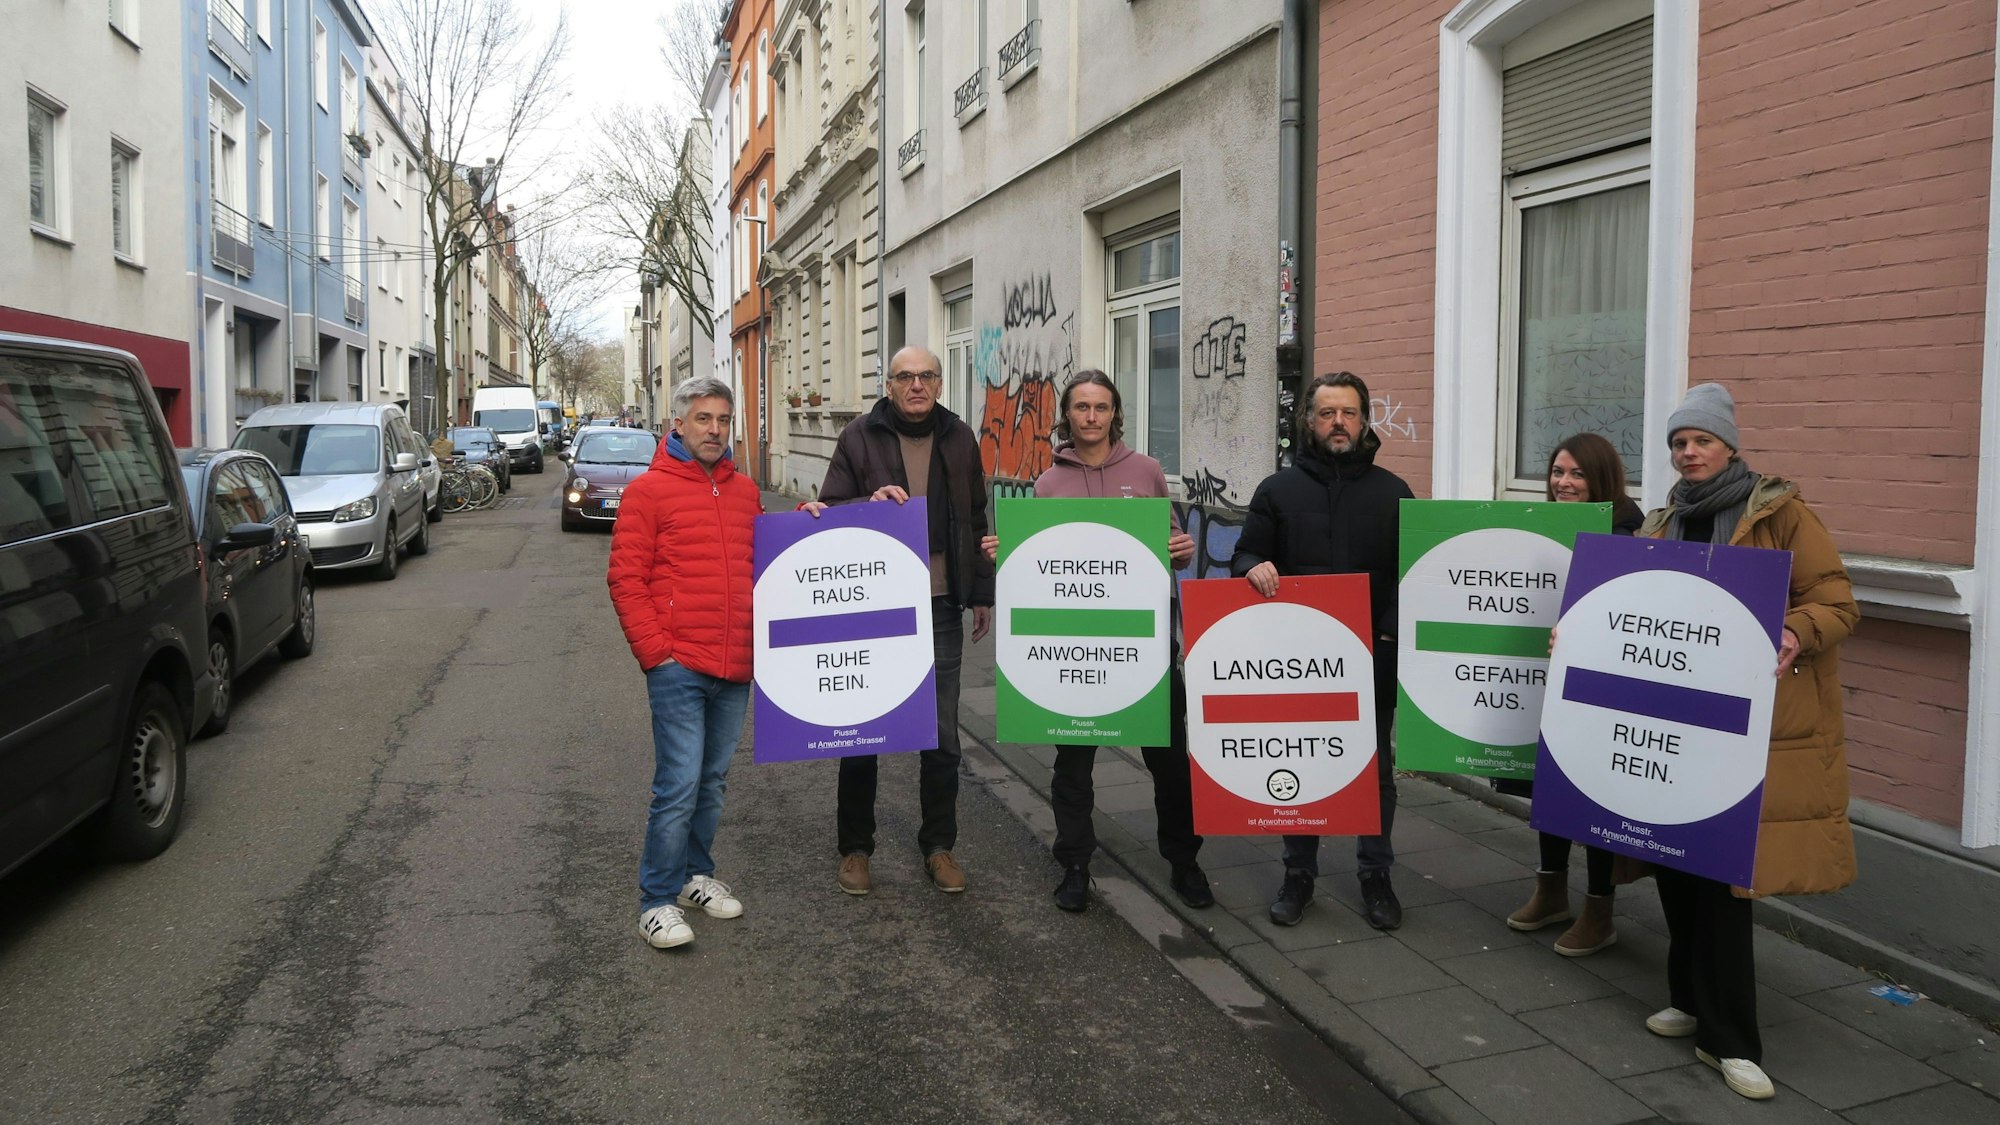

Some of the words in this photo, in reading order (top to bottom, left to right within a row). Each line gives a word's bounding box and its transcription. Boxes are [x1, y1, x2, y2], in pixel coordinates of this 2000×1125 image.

[795, 561, 886, 584] VERKEHR
[1037, 559, 1128, 576] VERKEHR
[1448, 568, 1558, 590] VERKEHR
[813, 585, 870, 605] RAUS.
[1054, 582, 1110, 599] RAUS.
[1468, 594, 1535, 615] RAUS.
[1608, 611, 1721, 647] VERKEHR
[816, 649, 871, 670] RUHE
[1027, 645, 1139, 663] ANWOHNER
[1622, 643, 1693, 674] RAUS.
[1059, 668, 1107, 685] FREI!
[1213, 657, 1344, 681] LANGSAM
[1455, 664, 1547, 686] GEFAHR
[818, 674, 869, 693] REIN.
[1473, 691, 1525, 711] AUS.
[1056, 728, 1121, 736] Anwohner-Strasse!
[1071, 719, 1097, 727] Piusstr.
[808, 741, 817, 749] ist
[818, 736, 886, 749] Anwohner-Strasse!
[833, 729, 860, 737] Piusstr.
[1612, 724, 1681, 755] RUHE
[1484, 747, 1514, 758] Piusstr.
[1455, 755, 1465, 764] ist
[1466, 756, 1536, 770] Anwohner-Strass
[1611, 754, 1673, 785] REIN.
[1258, 817, 1328, 826] Anwohner-Strasse!
[1273, 808, 1300, 816] Piusstr.
[1621, 821, 1654, 837] Piusstr.
[1590, 824, 1601, 835] ist
[1601, 828, 1685, 858] Anwohner-Strasse!
